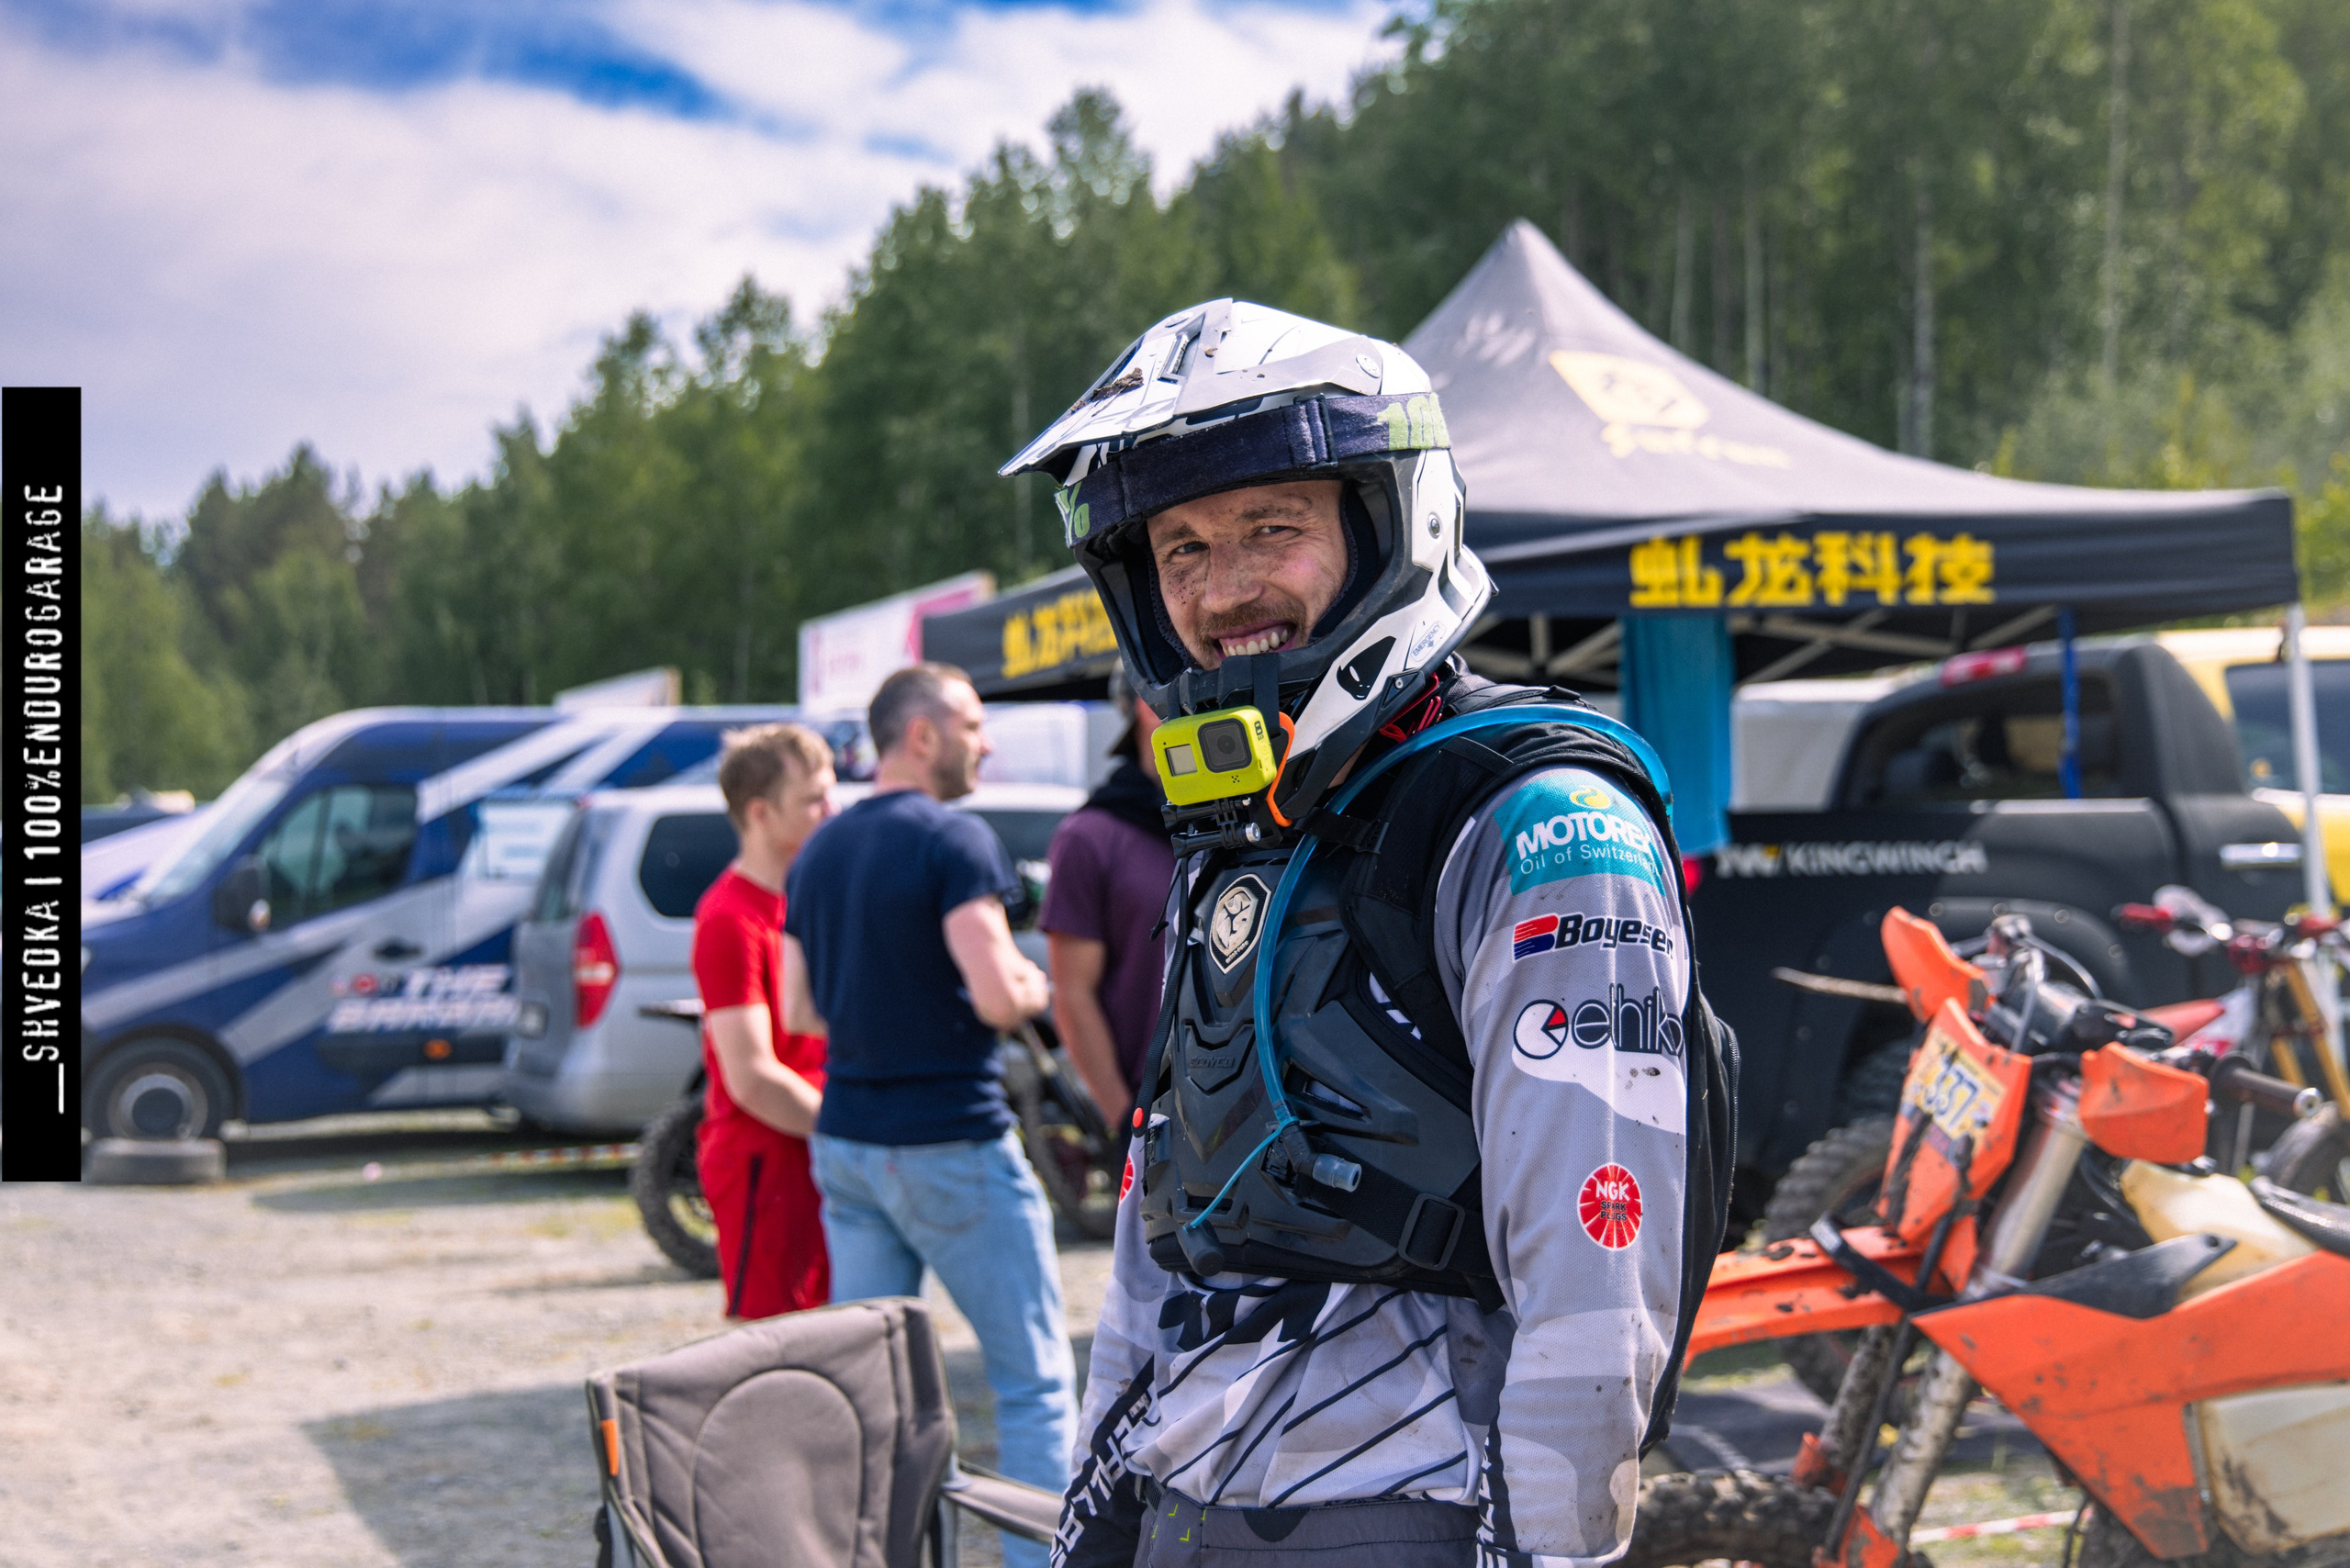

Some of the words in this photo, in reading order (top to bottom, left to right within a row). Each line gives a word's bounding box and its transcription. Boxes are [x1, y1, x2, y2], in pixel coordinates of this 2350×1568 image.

[1520, 854, 1546, 875] Oil
[1554, 846, 1572, 865] of
[1580, 844, 1657, 874] Switzerlan
[1785, 840, 1988, 875] KINGWINCH
[1595, 1181, 1630, 1202] NGK
[1600, 1211, 1627, 1221] PLUGS
[1601, 1201, 1627, 1212] SPARK
